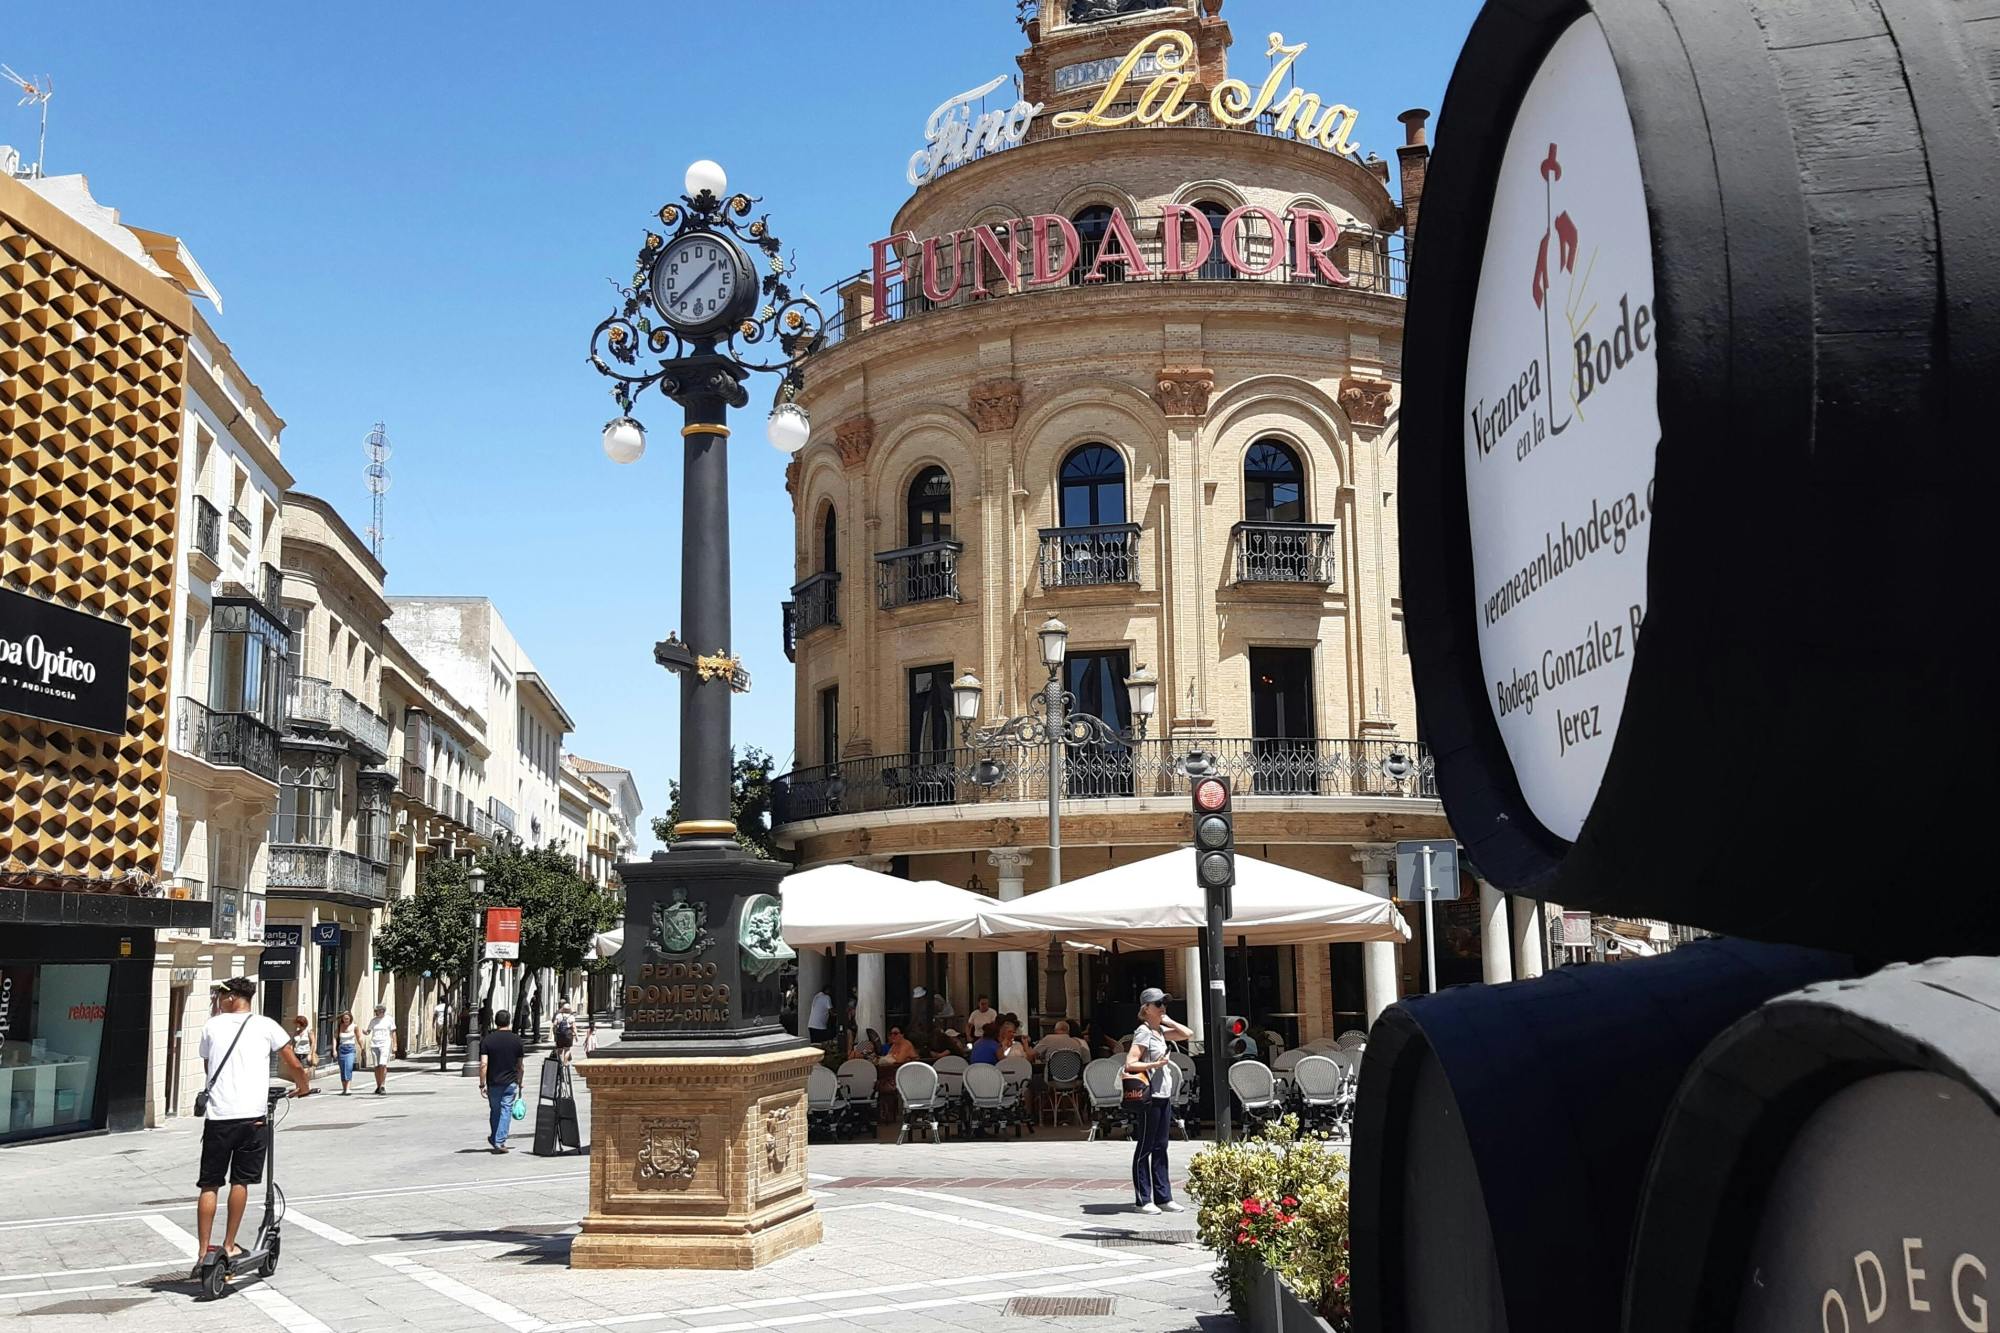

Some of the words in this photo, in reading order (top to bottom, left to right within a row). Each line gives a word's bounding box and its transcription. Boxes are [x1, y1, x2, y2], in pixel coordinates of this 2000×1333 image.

[907, 74, 1045, 187] Fino
[1052, 29, 1198, 129] La
[868, 204, 1351, 325] FUNDADOR
[1573, 292, 1655, 406] Bode
[1471, 358, 1541, 463] Veranea
[1516, 427, 1531, 462] en
[1533, 409, 1545, 447] la
[26, 634, 96, 684] Optico
[1497, 668, 1540, 717] Bodega
[1542, 620, 1625, 692] González
[22, 682, 76, 700] AUDIOLOGÍA
[1556, 703, 1602, 757] Jerez
[625, 983, 731, 1005] DOMECQ
[641, 962, 718, 979] PEDRO
[68, 1002, 107, 1022] rebajas
